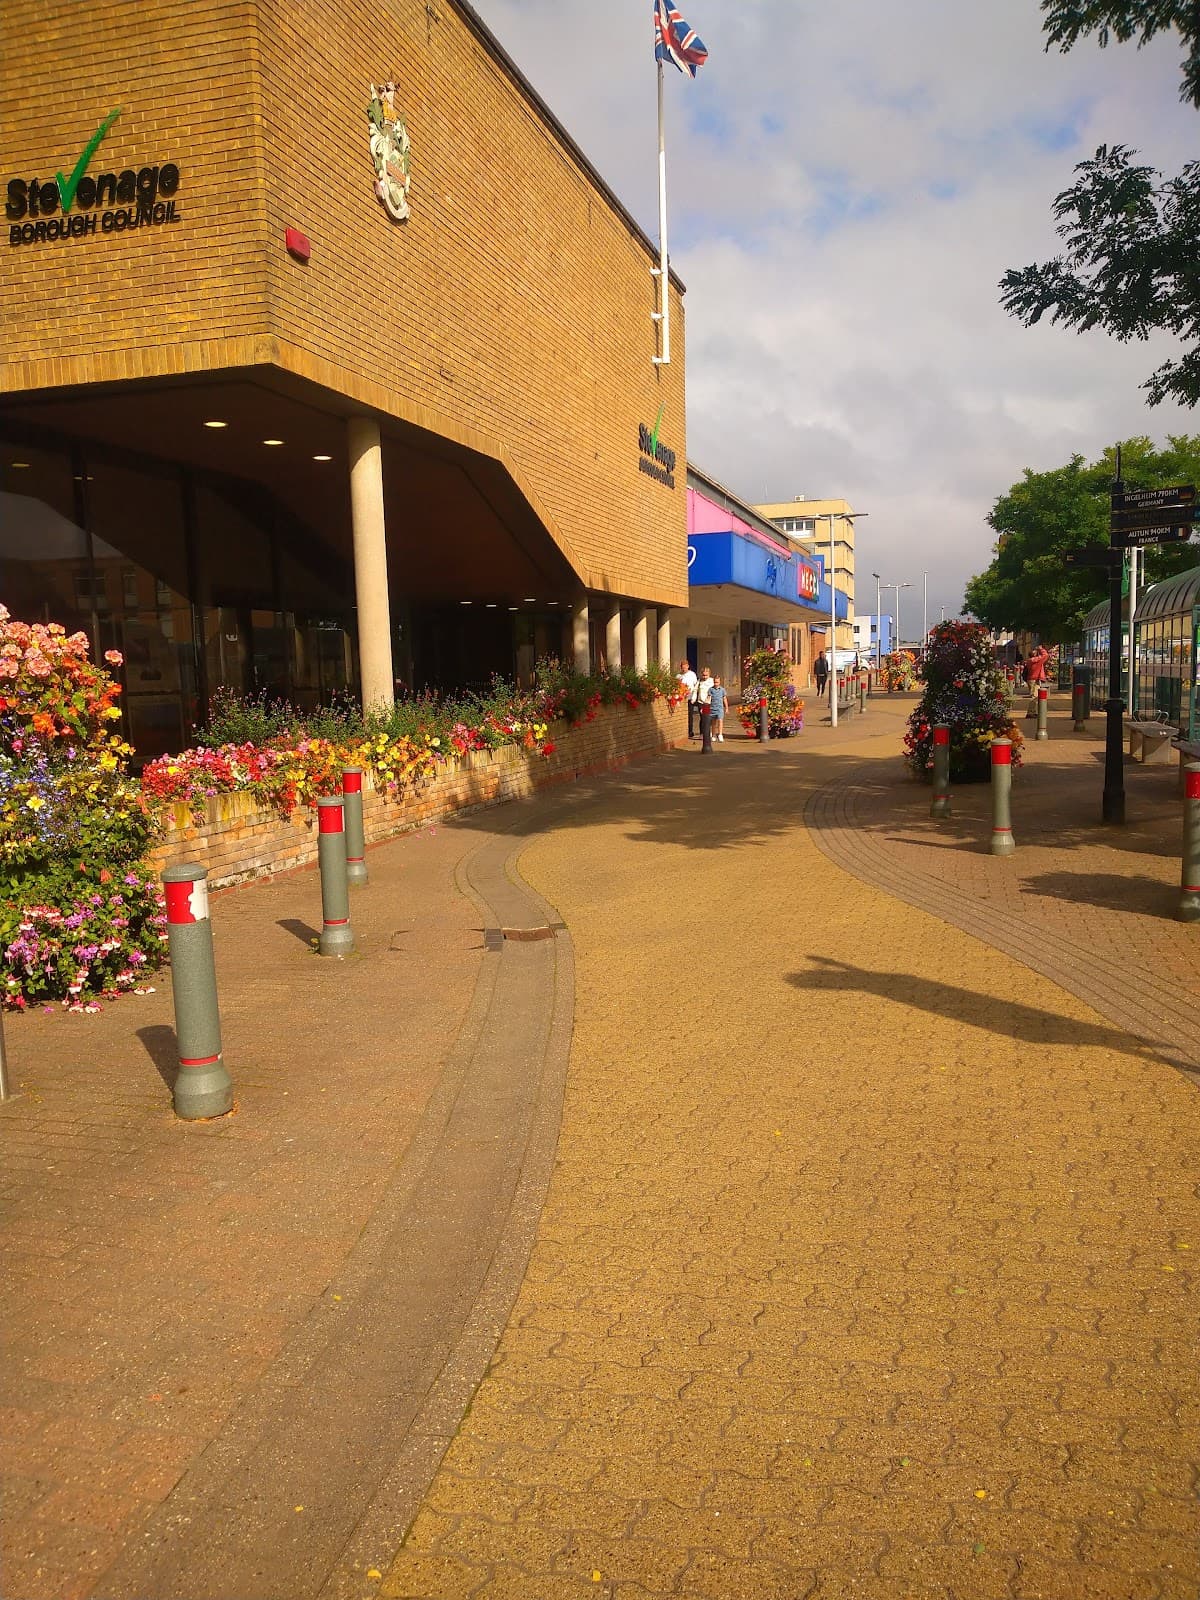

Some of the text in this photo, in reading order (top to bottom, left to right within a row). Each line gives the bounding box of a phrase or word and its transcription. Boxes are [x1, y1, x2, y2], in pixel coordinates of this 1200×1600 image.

[9, 200, 181, 247] BOROUGH COUNCIL
[1124, 491, 1157, 502] INGELHEIM
[1137, 499, 1164, 507] GERMANY
[1128, 529, 1150, 538] AUTUN
[1138, 536, 1159, 544] FRANCE
